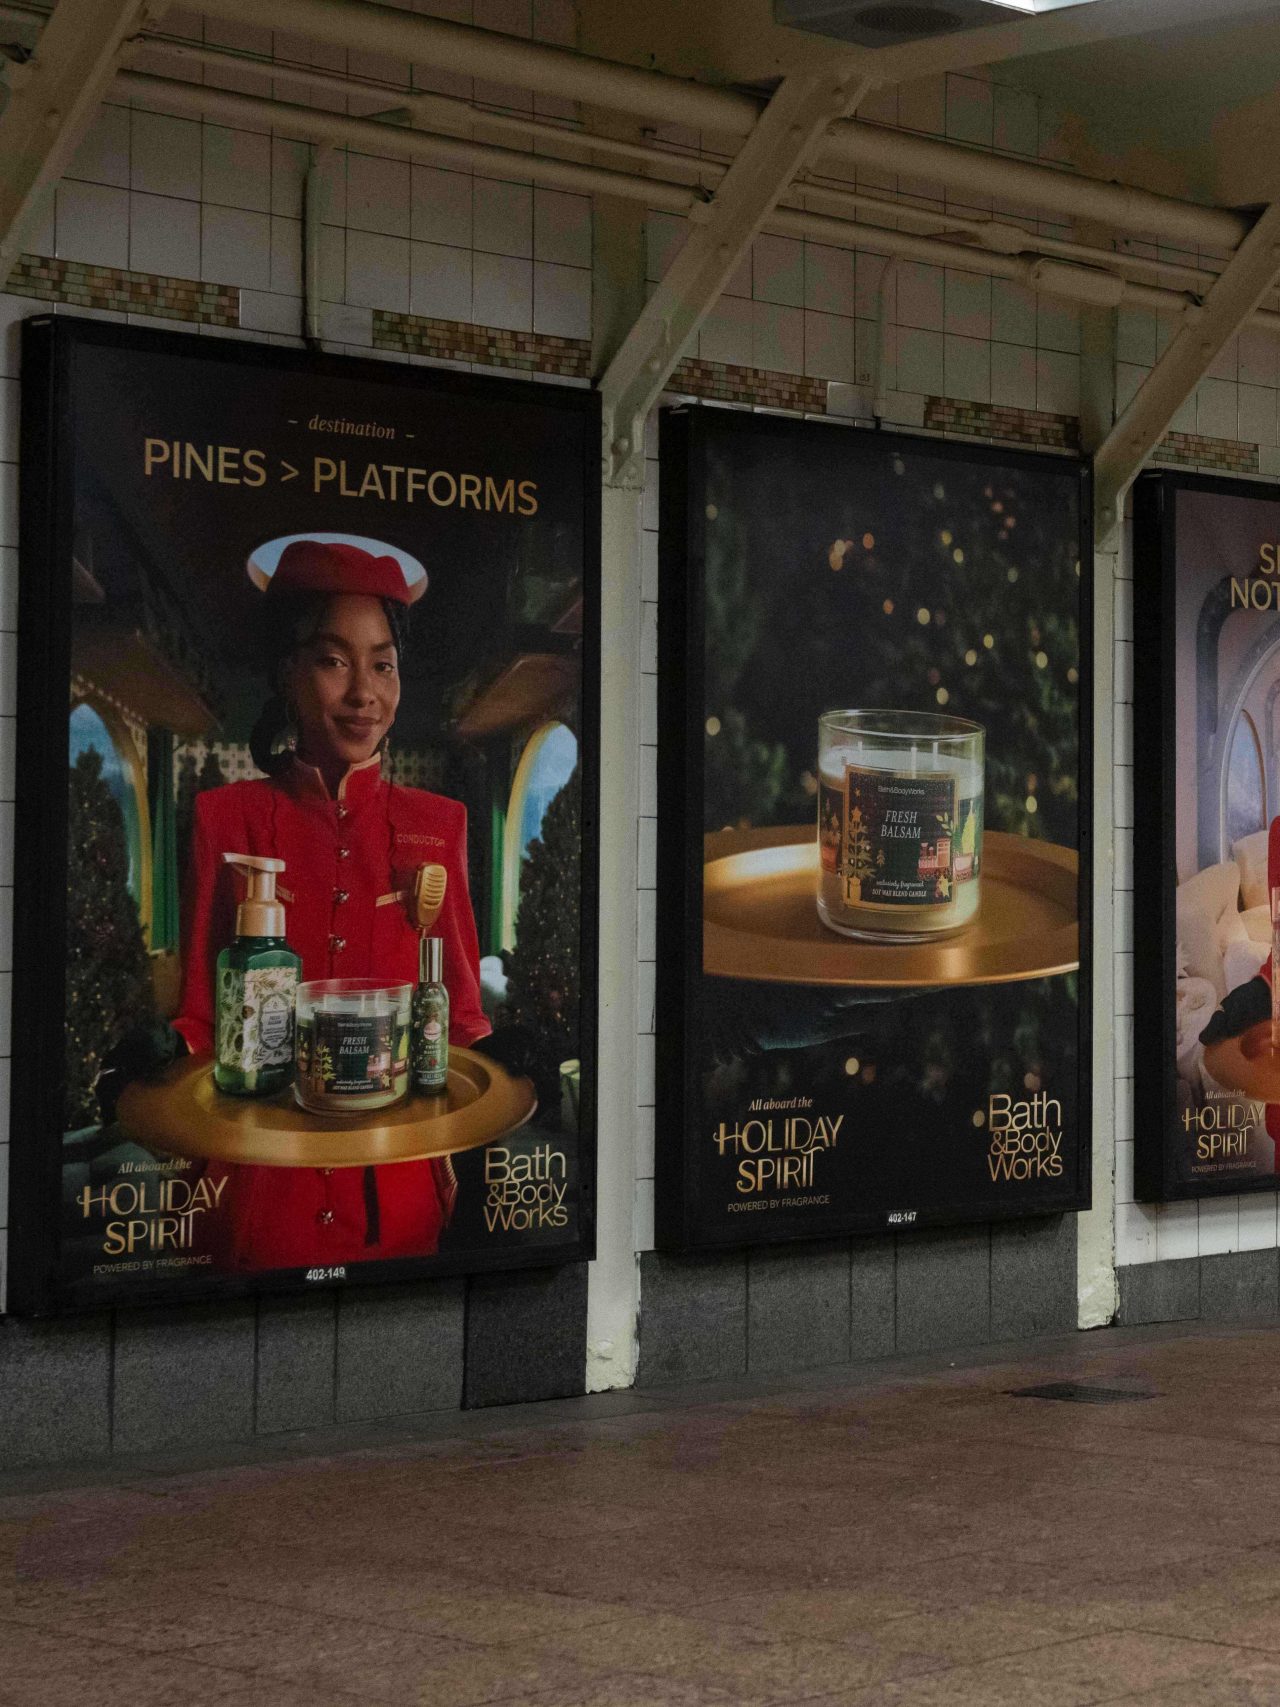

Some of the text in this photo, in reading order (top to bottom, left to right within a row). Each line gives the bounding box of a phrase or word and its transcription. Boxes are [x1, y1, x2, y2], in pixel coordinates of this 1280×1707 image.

[308, 414, 396, 440] destination
[144, 438, 267, 487] PINES
[313, 457, 538, 516] PLATFORMS
[885, 810, 918, 823] FRESH
[881, 825, 921, 839] BALSAM
[339, 1045, 370, 1055] BALSAM
[342, 1036, 367, 1045] FRESH
[749, 1096, 813, 1111] All aboard the
[989, 1091, 1061, 1131] Bath
[1182, 1103, 1265, 1132] HOLIDAY
[713, 1114, 845, 1155] HOLIDAY
[991, 1126, 1063, 1157] &Body
[1196, 1125, 1253, 1159] SPIRIT
[118, 1158, 192, 1175] All aboard the
[485, 1144, 566, 1184] Bath
[736, 1146, 825, 1193] SPIRIT
[987, 1149, 1063, 1182] Works
[76, 1176, 229, 1218] HOLIDAY
[487, 1177, 568, 1208] &Body
[728, 1195, 830, 1212] POWERED BY FRAGRANCE
[103, 1207, 206, 1255] SPIRIT
[483, 1200, 568, 1232] Works
[888, 1212, 917, 1224] 402-147
[93, 1255, 213, 1274] POWERED BY FRAGRANCE
[306, 1267, 346, 1281] 402-149
